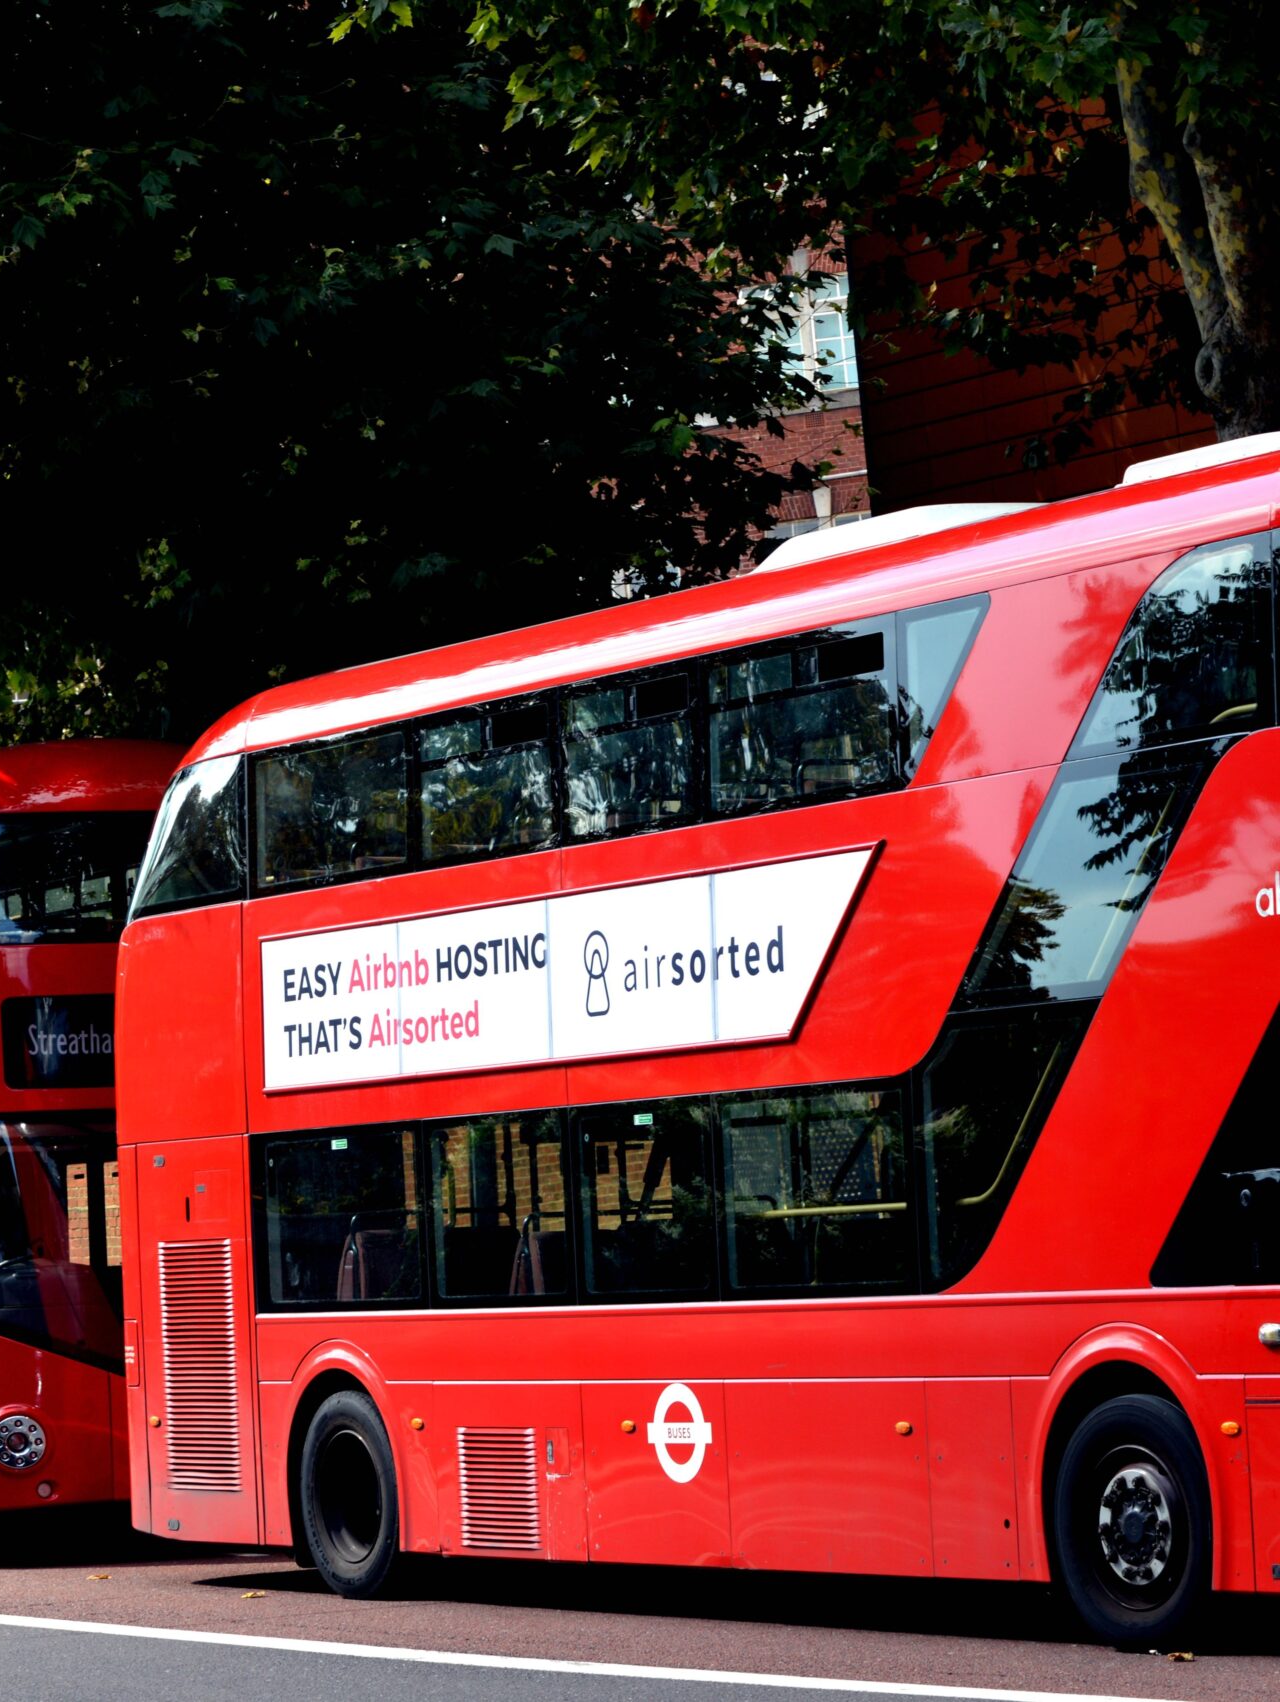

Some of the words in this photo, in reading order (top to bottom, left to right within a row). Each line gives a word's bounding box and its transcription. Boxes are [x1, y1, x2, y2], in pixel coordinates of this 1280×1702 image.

[283, 961, 342, 1003] EASY
[348, 949, 429, 993] Airbnb
[436, 932, 548, 983] HOSTING
[624, 925, 784, 992] airsorted
[284, 1016, 362, 1057] THAT'S
[368, 1000, 480, 1048] Airsorted
[667, 1427, 691, 1439] BUSES
